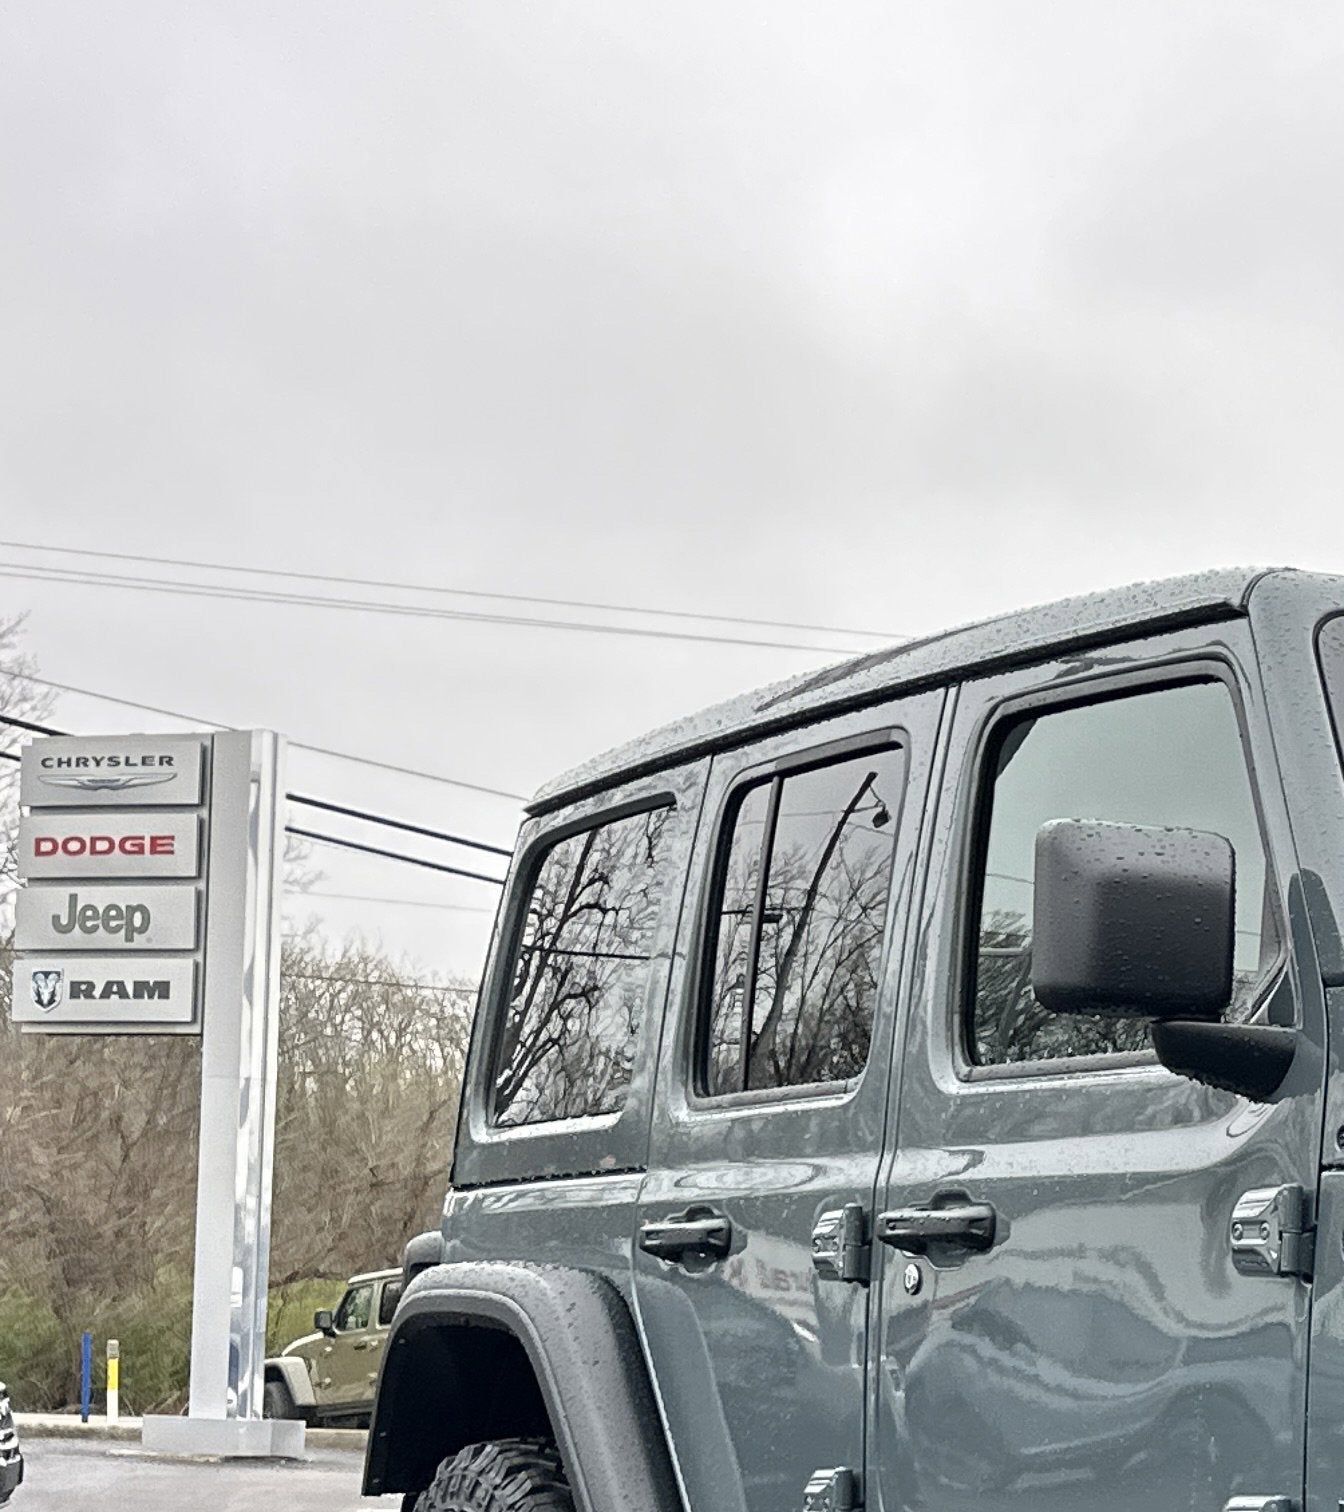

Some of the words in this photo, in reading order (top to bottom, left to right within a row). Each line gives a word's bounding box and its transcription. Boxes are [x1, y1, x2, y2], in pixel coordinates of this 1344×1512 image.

[41, 755, 174, 768] CHRYSLER
[34, 835, 175, 857] DODGE
[51, 893, 151, 943] Jeep
[69, 980, 171, 1000] RAM
